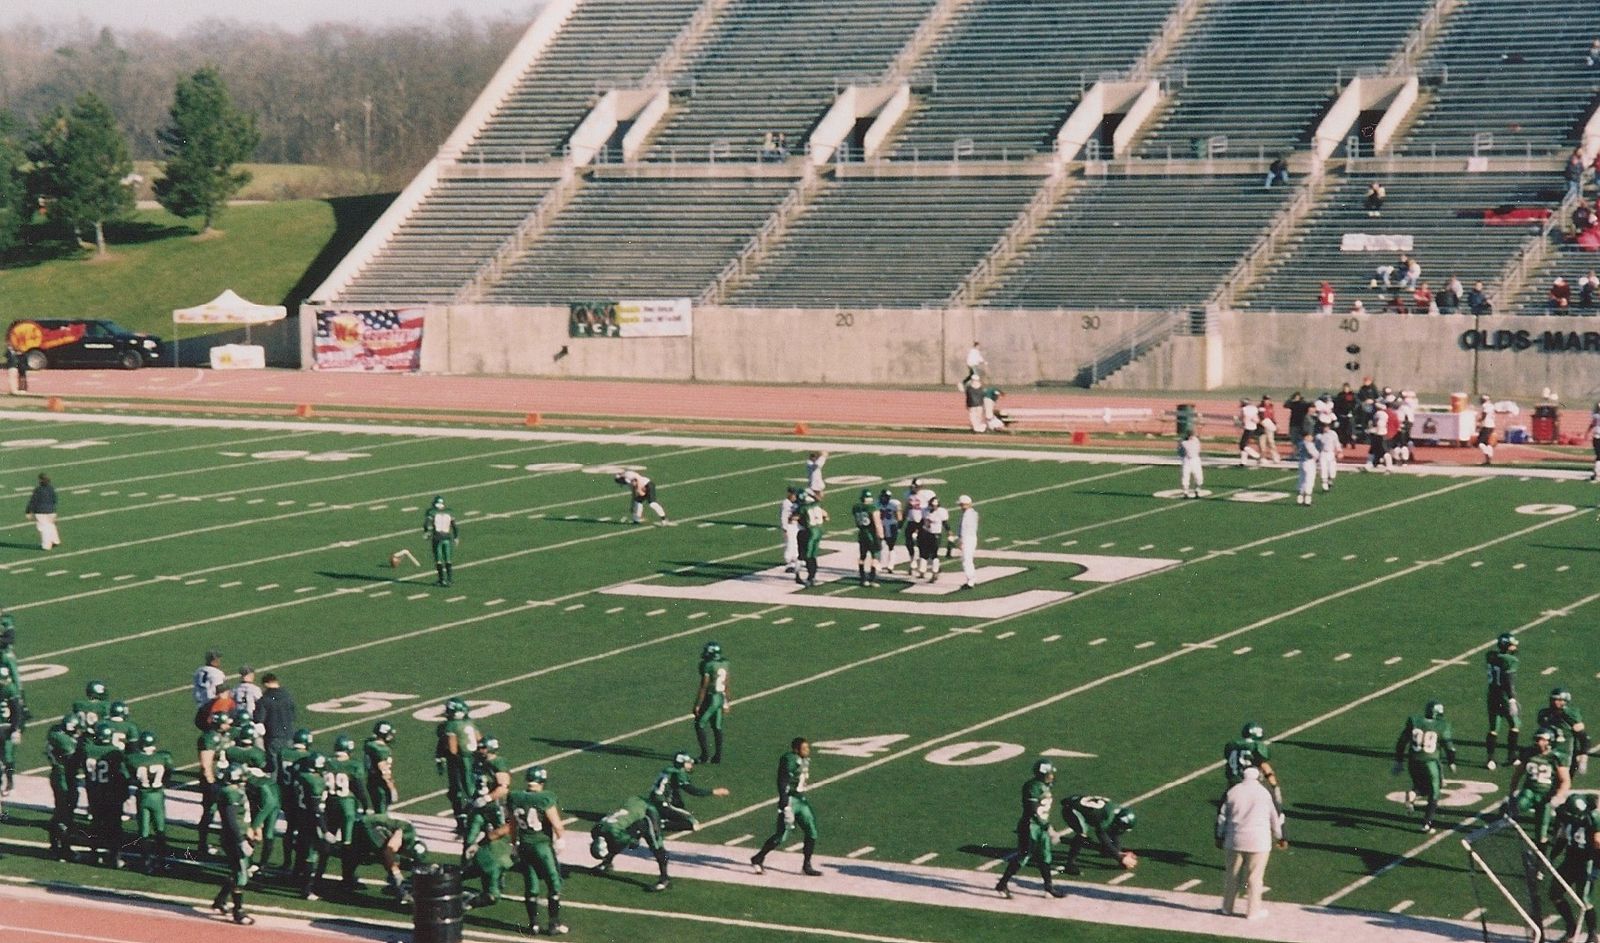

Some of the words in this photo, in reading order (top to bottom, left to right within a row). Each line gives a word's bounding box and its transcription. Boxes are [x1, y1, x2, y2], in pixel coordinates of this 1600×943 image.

[835, 313, 854, 327] 20
[1081, 315, 1101, 330] 30
[1338, 317, 1360, 333] 40
